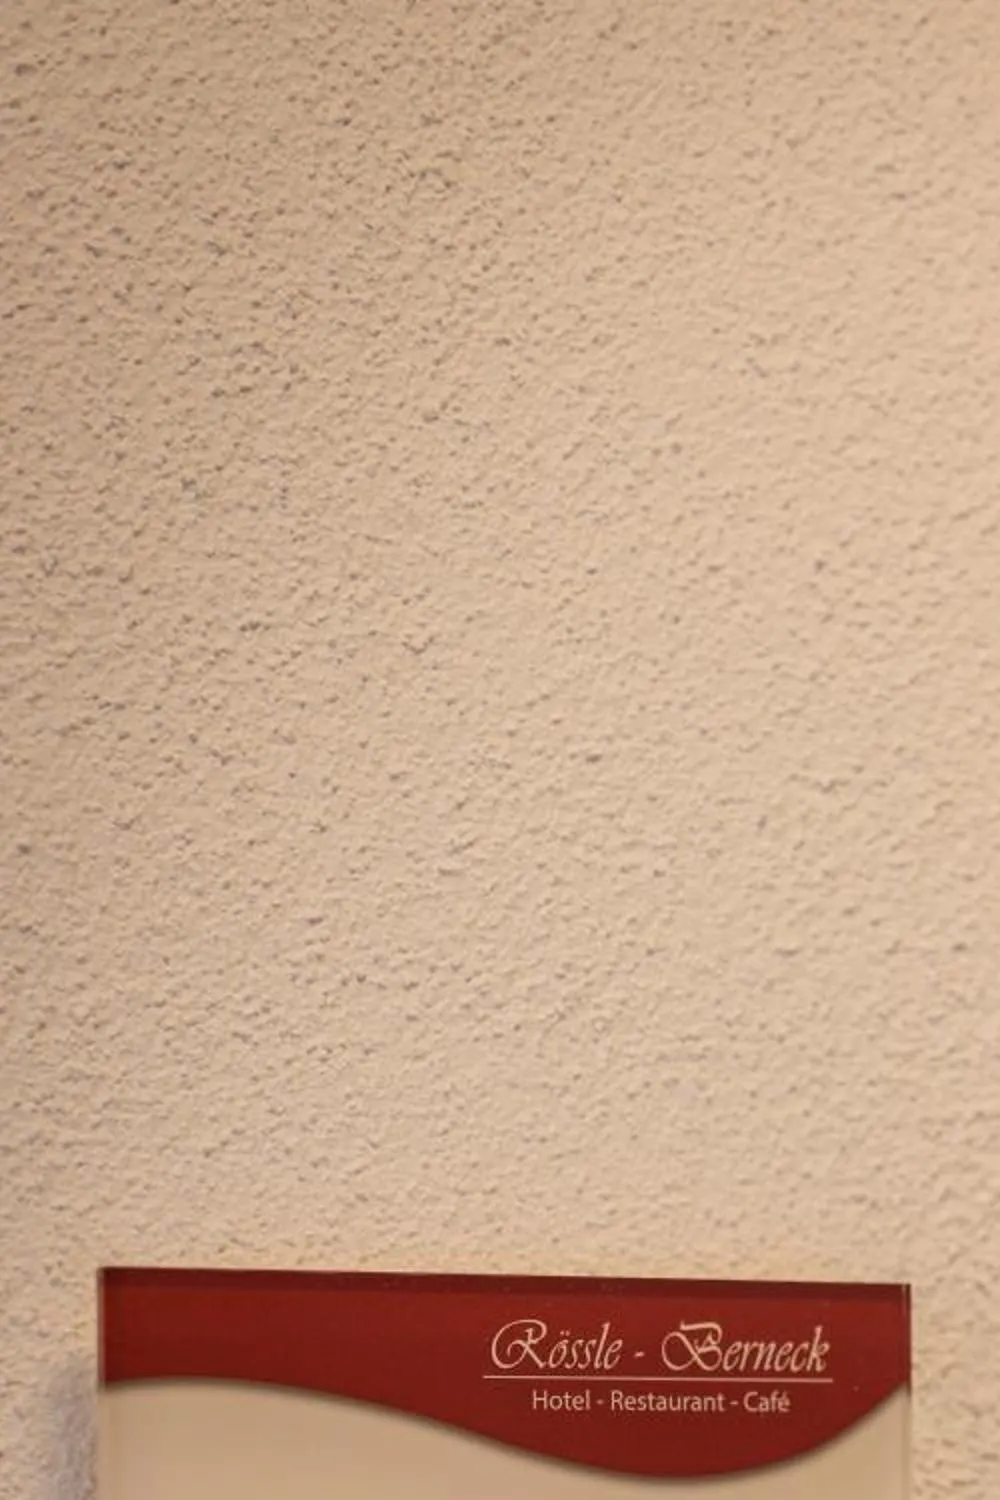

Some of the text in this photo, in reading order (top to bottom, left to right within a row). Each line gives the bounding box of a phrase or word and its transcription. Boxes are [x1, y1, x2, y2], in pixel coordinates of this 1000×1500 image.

[491, 1318, 624, 1370] Rössle
[660, 1319, 831, 1373] Berneck
[531, 1389, 591, 1411] Hotel
[610, 1390, 726, 1412] Restaurant
[742, 1389, 791, 1413] Café
